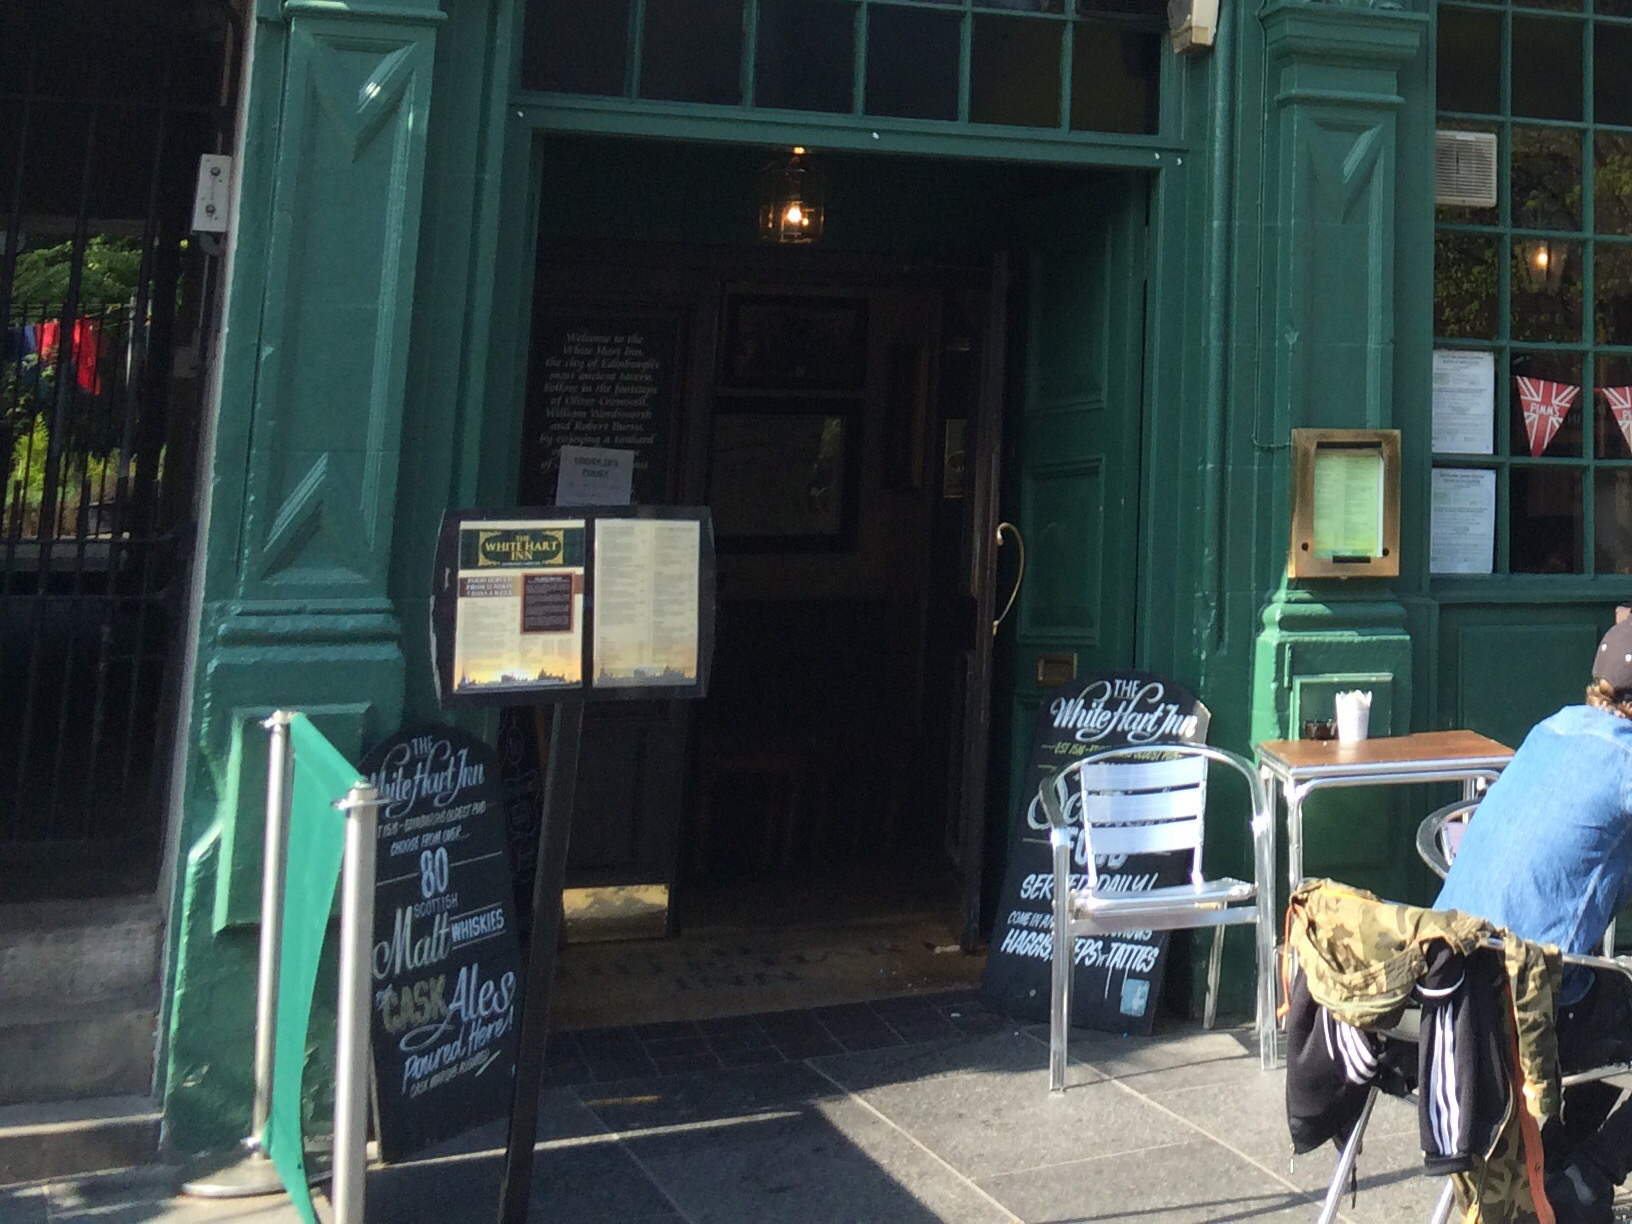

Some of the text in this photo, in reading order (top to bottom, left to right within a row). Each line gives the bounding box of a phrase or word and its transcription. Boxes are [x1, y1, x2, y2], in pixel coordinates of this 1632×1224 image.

[485, 541, 558, 552] WHITE HART
[510, 551, 533, 561] INN
[1113, 678, 1142, 699] THE
[1050, 680, 1112, 729] White
[411, 735, 434, 756] THE
[419, 846, 450, 899] 80
[1020, 872, 1094, 901] SERED
[413, 892, 459, 919] SCOTTISH
[1007, 910, 1029, 926] COME
[373, 905, 505, 980] Malt WHISKIES
[1105, 941, 1161, 973] TATTIES
[382, 972, 448, 1034] CASK
[402, 1024, 467, 1095] Poured
